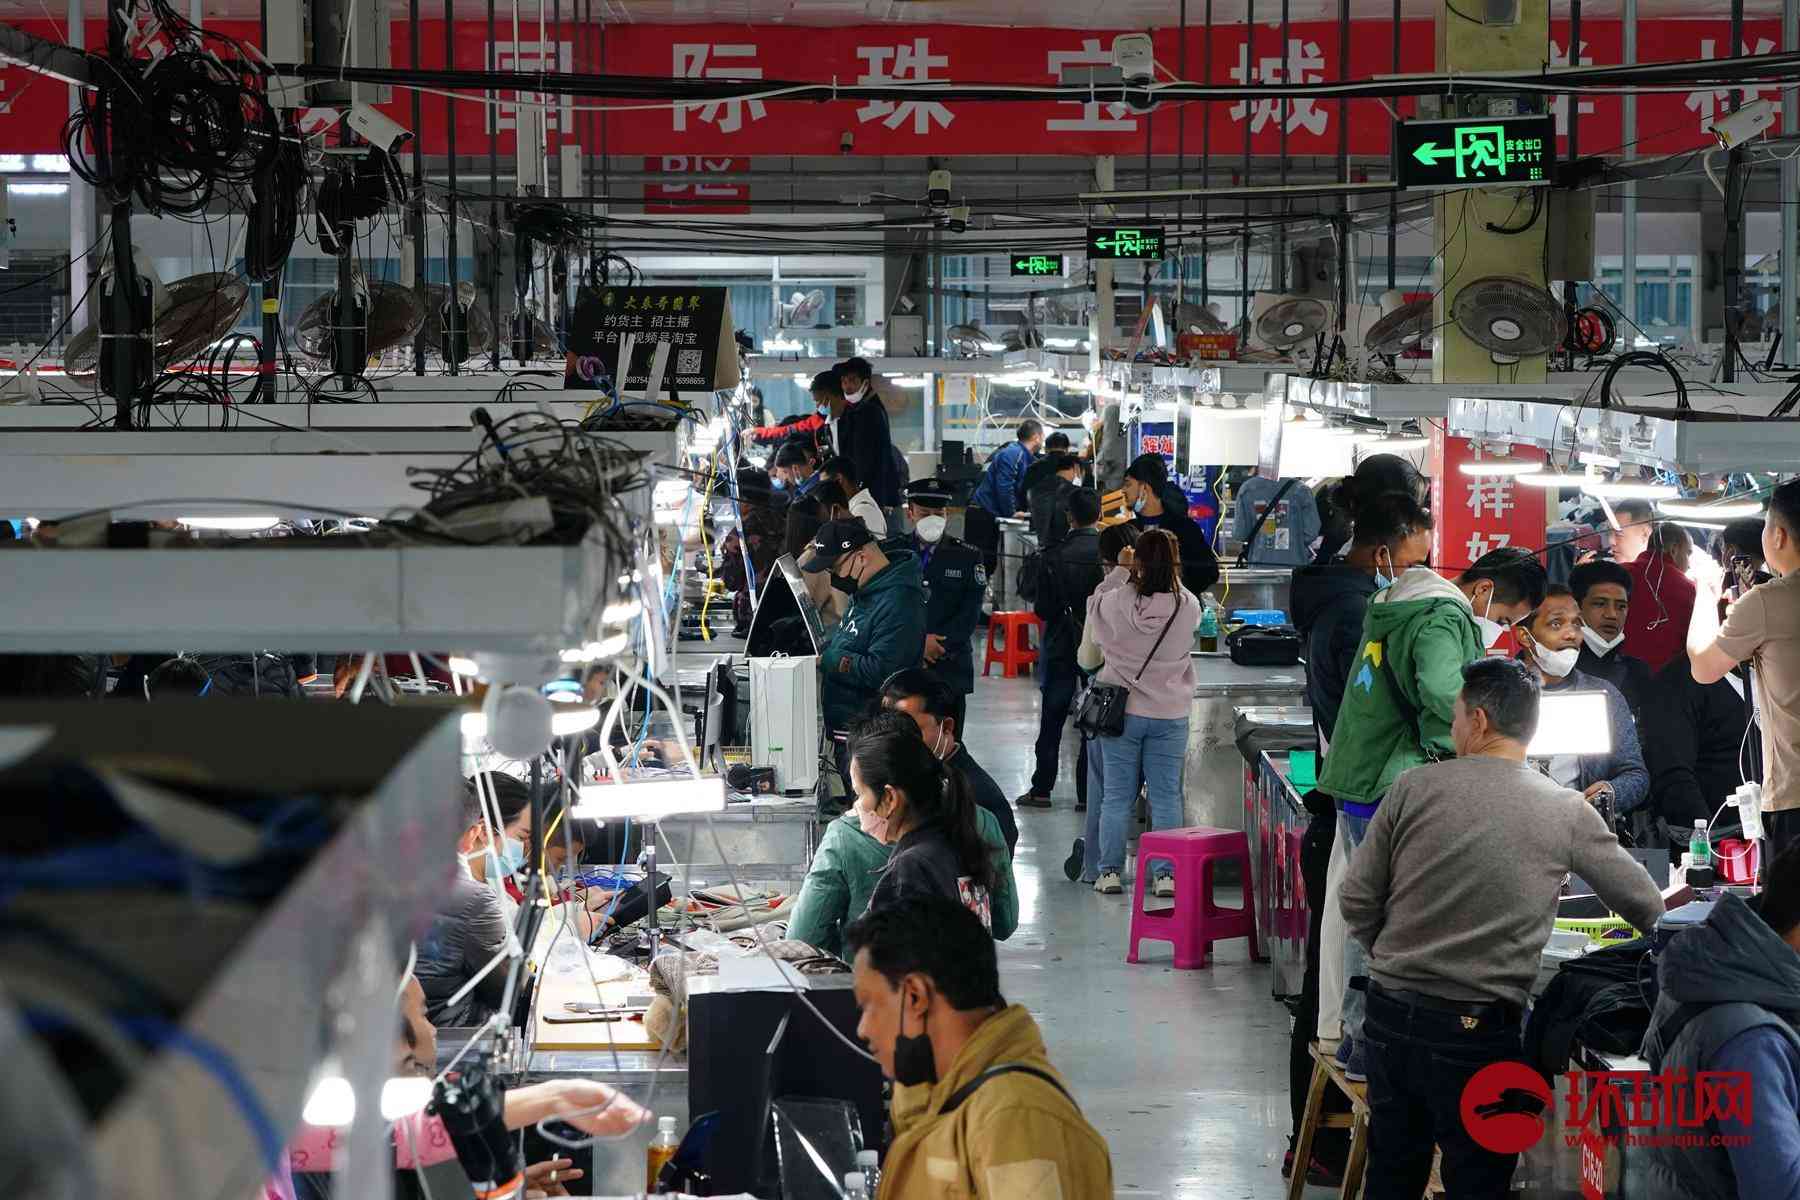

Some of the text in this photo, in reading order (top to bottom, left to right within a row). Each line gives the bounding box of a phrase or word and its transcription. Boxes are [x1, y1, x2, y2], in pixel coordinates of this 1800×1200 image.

[1505, 138, 1542, 151] 安全出口
[1506, 151, 1542, 163] EXIT
[650, 315, 690, 328] 招主播
[592, 331, 618, 344] 平台
